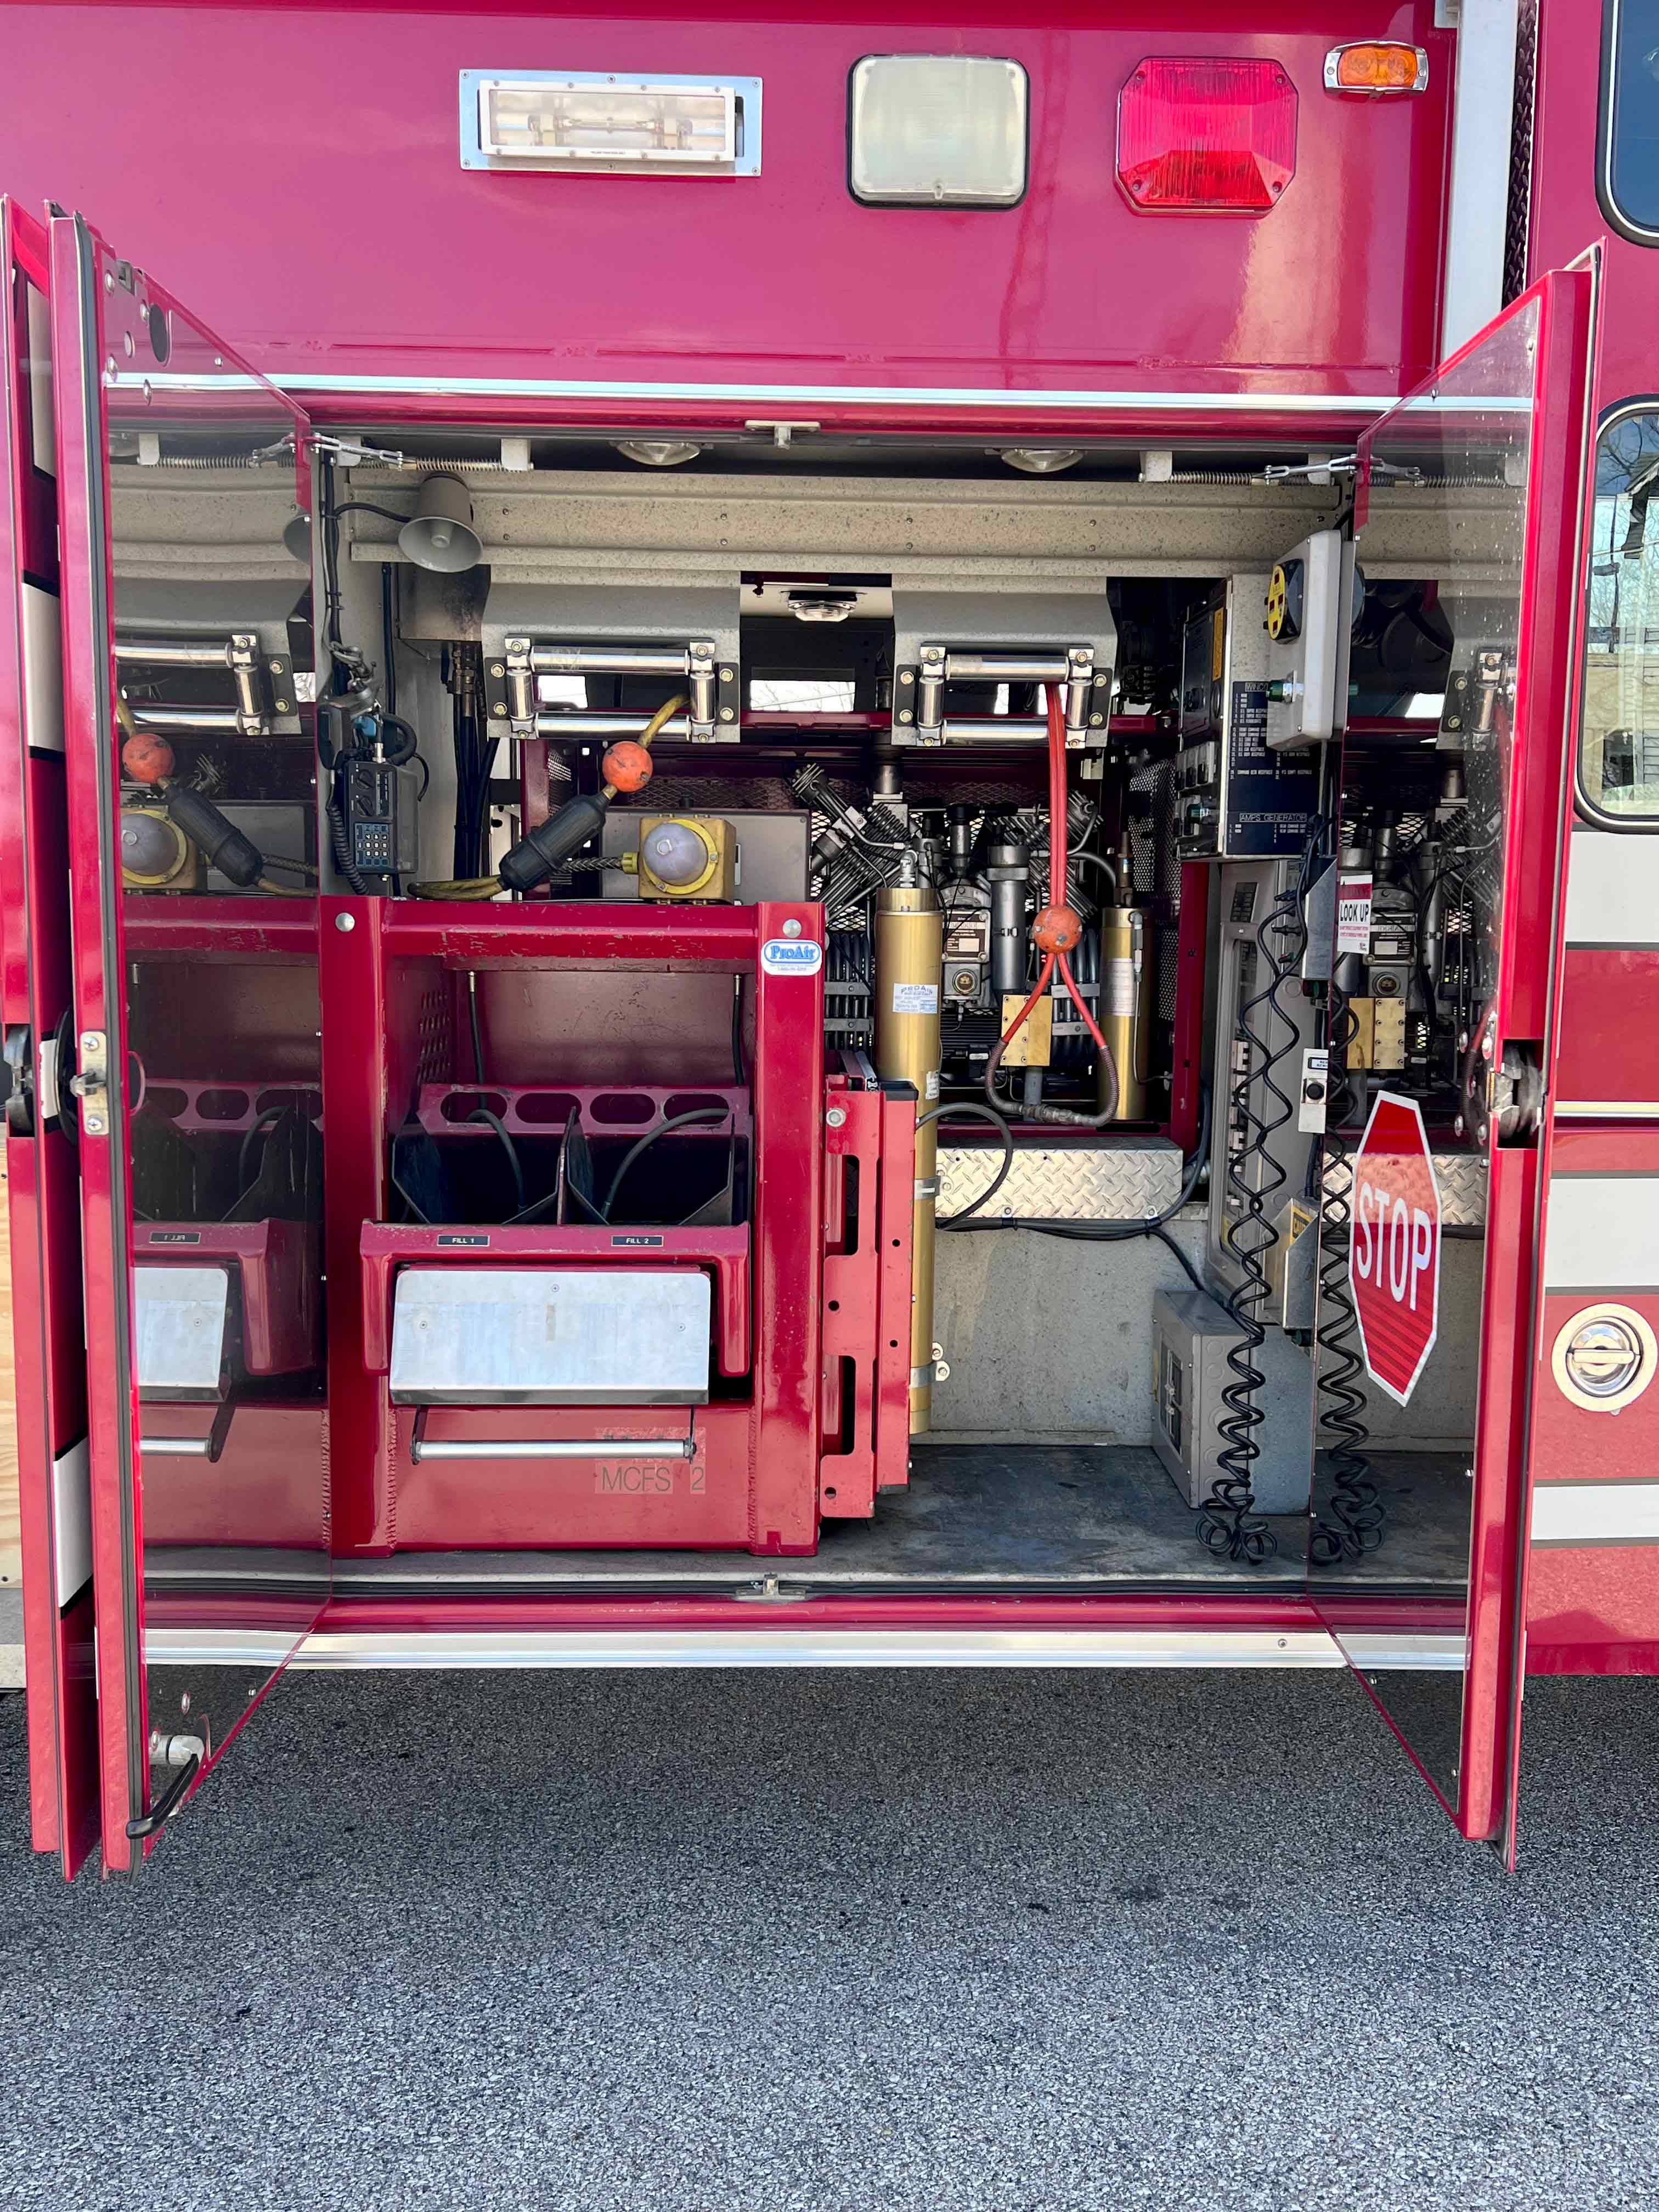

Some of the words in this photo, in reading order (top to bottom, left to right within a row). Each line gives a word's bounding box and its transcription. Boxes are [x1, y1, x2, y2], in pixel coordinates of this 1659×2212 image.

[1340, 904, 1357, 922] LOOK
[1360, 904, 1369, 922] UP
[770, 945, 816, 960] ProAir
[1357, 1182, 1432, 1311] STOP
[602, 1466, 671, 1492] MCFS
[691, 1466, 704, 1491] 2
